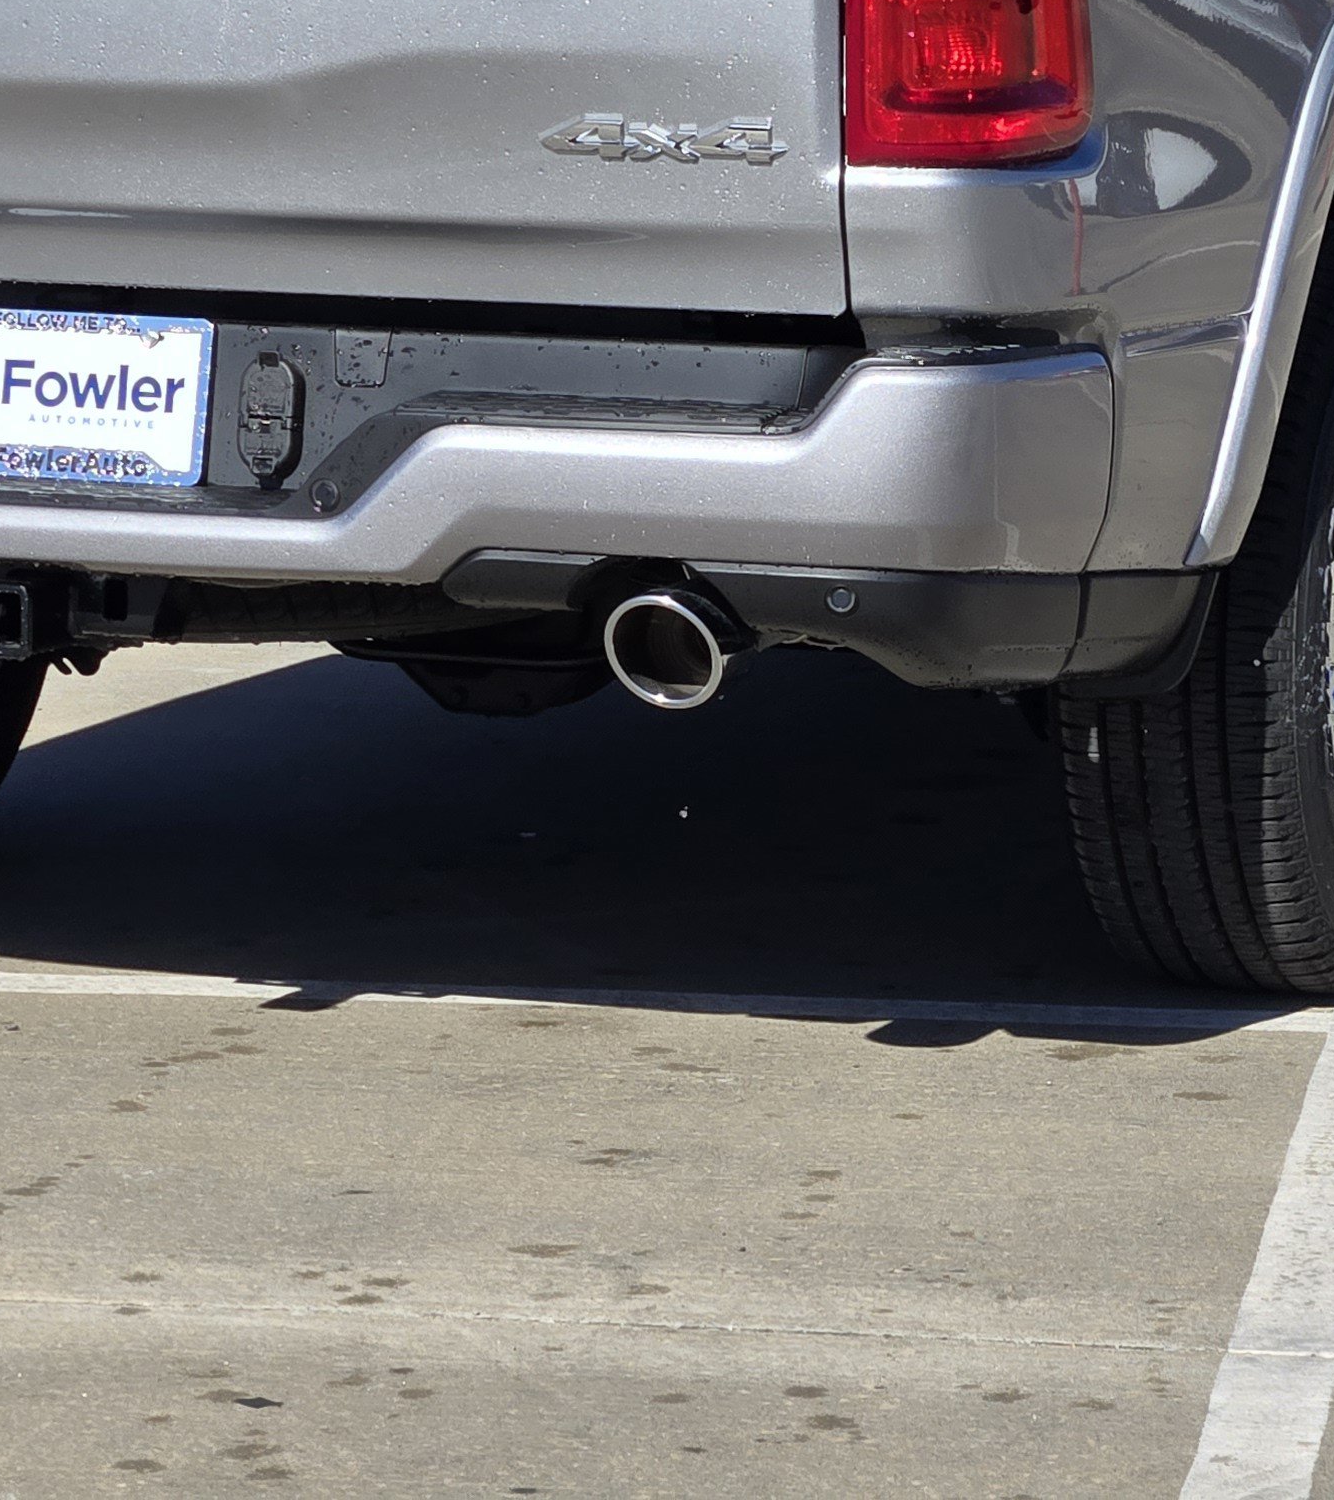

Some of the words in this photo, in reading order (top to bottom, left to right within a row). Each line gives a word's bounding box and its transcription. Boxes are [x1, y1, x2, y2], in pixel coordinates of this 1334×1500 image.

[538, 113, 789, 167] 4x4
[73, 315, 99, 330] ME
[1, 358, 185, 413] Fowler
[28, 414, 154, 429] AUTOMOTIVE
